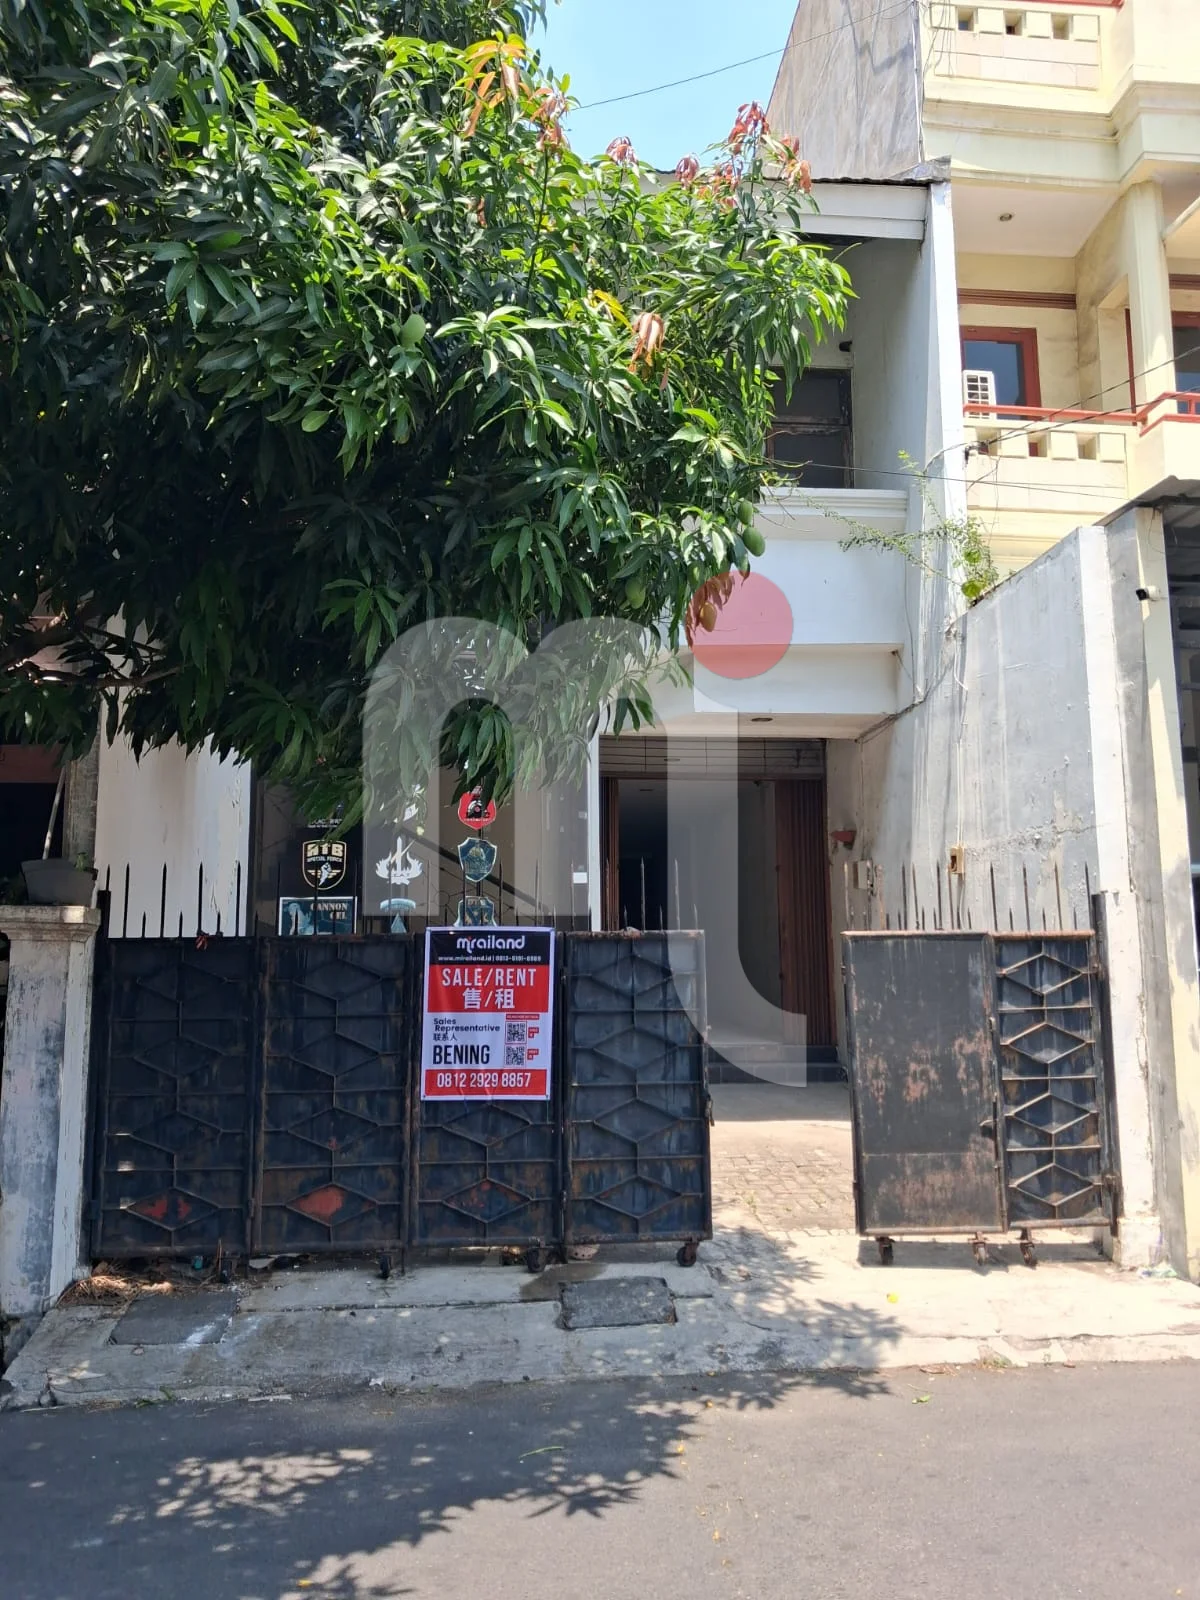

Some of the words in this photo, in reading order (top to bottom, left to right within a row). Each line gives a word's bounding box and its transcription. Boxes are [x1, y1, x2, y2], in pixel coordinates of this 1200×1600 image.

[456, 935, 526, 953] mirailand
[442, 968, 537, 987] SALE/RENT
[462, 988, 515, 1009] 售/租
[433, 1017, 457, 1025] Sales
[435, 1025, 500, 1034] Representative
[432, 1044, 490, 1065] BENING
[437, 1072, 467, 1088] 0812
[469, 1072, 499, 1088] 2929
[501, 1072, 532, 1088] 8857
